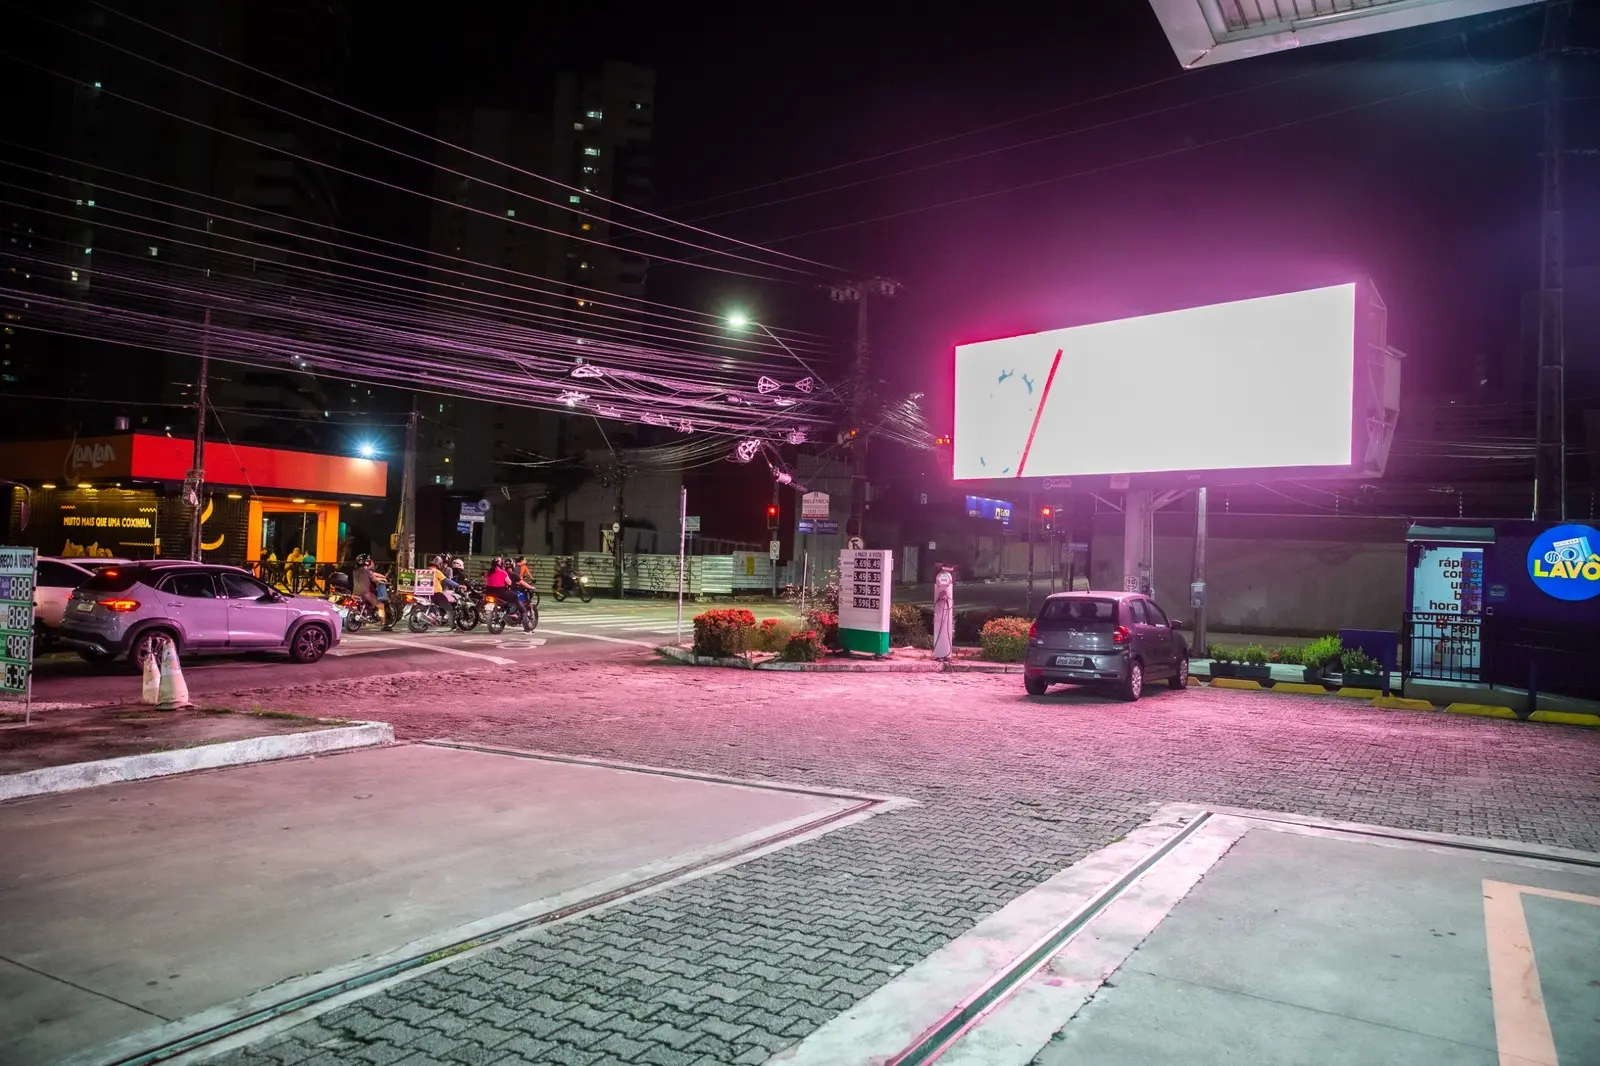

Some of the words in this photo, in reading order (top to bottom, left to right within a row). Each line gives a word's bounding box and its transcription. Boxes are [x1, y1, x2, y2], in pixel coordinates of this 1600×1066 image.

[63, 516, 81, 526] MUITO
[81, 517, 95, 526] MAIS
[95, 517, 108, 527] QUE
[108, 518, 121, 527] UMA
[122, 518, 152, 528] COXINHA.
[1450, 581, 1479, 590] uma
[1429, 600, 1459, 610] hora
[1452, 624, 1478, 635] seja
